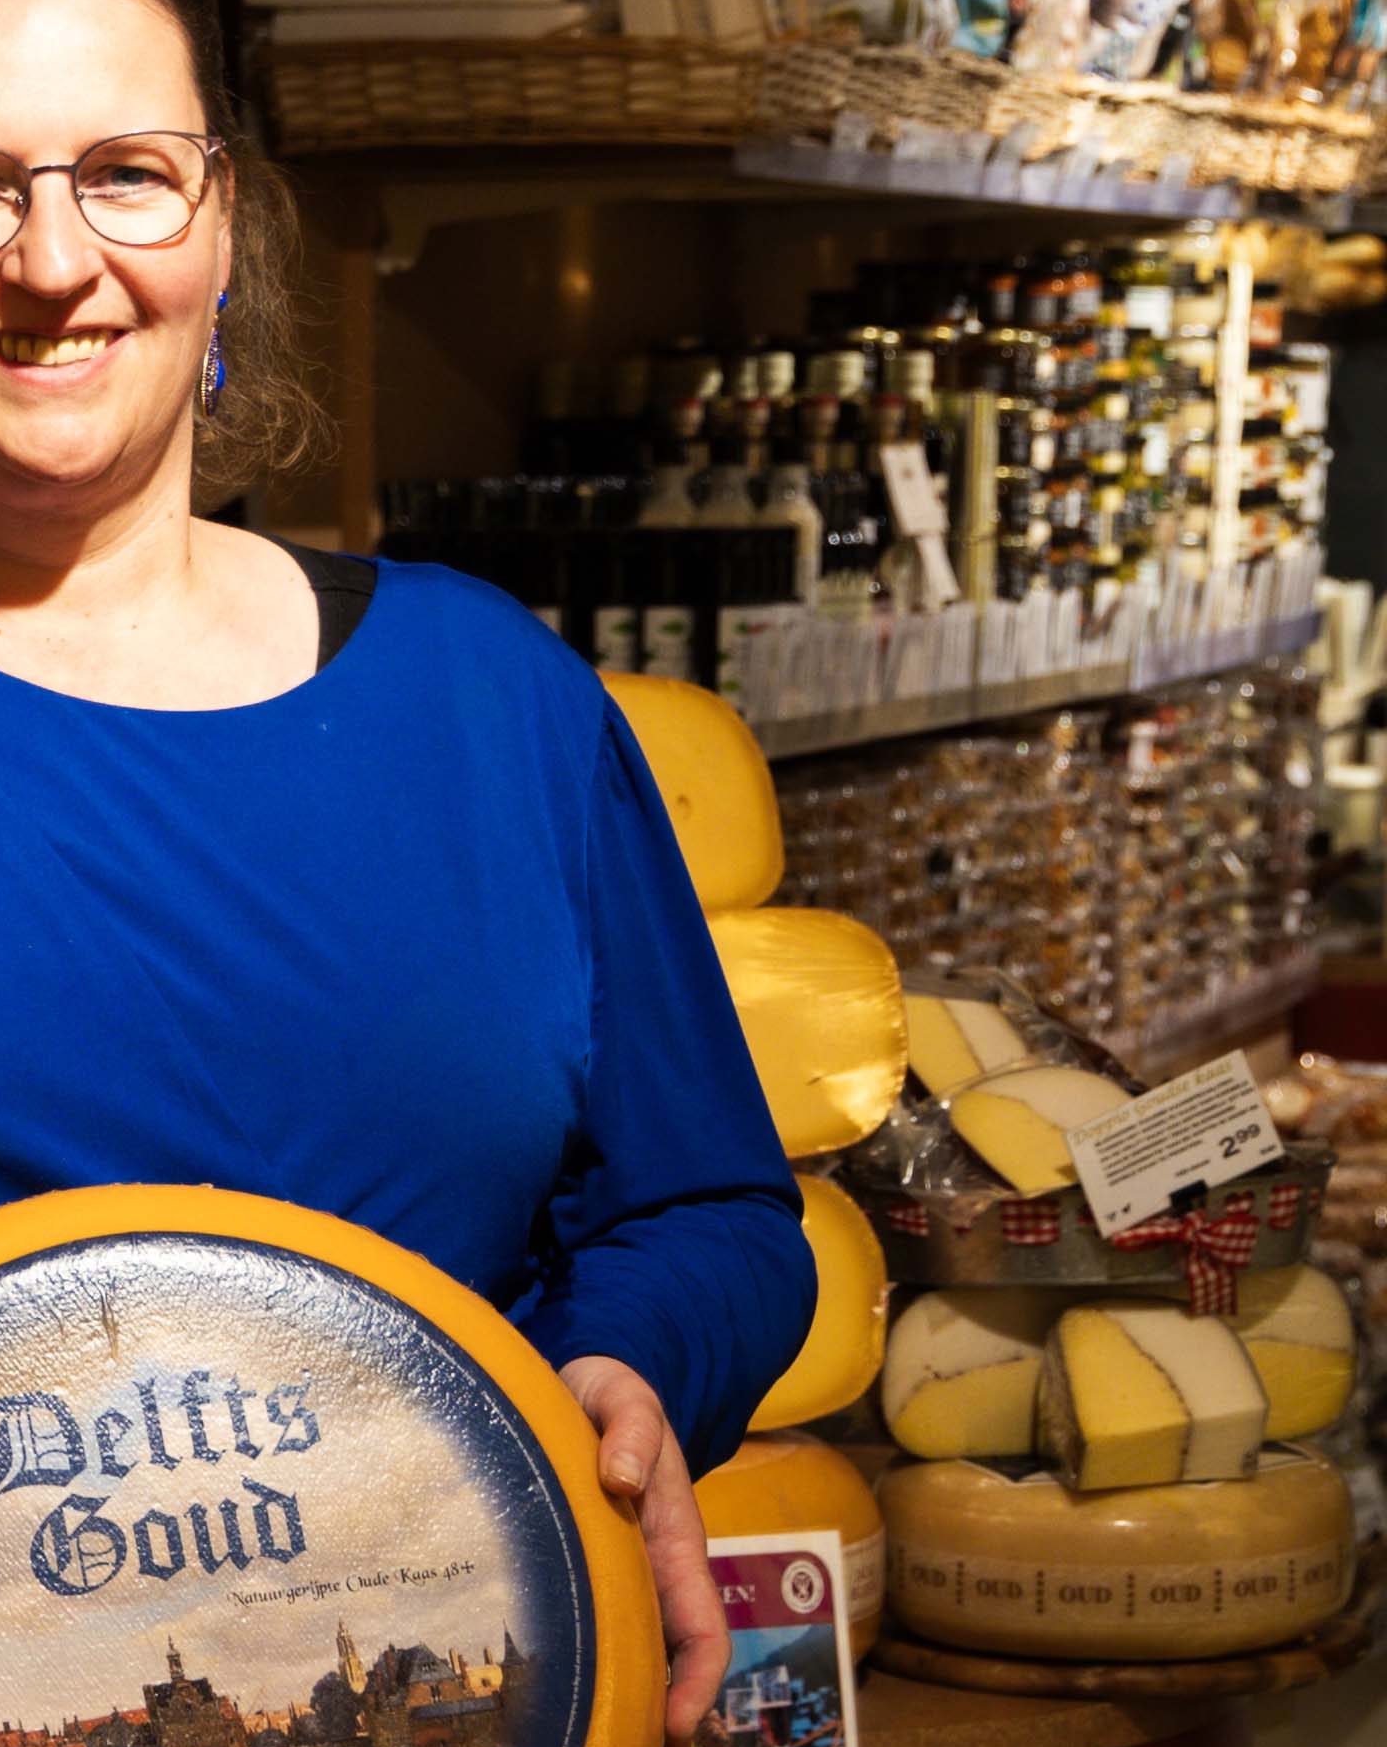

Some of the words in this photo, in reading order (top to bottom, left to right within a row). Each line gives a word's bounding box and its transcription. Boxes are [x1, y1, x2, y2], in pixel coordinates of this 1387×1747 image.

[1218, 1122, 1262, 1159] 299
[28, 1475, 308, 1597] Goud
[230, 1580, 341, 1608] Natuurgerijpte
[392, 1566, 438, 1590] Kaas
[911, 1563, 946, 1589] OUD
[976, 1577, 1023, 1601] OUD
[1059, 1583, 1113, 1606] OUD
[1150, 1583, 1202, 1605] OUD
[1233, 1573, 1277, 1599] OUD
